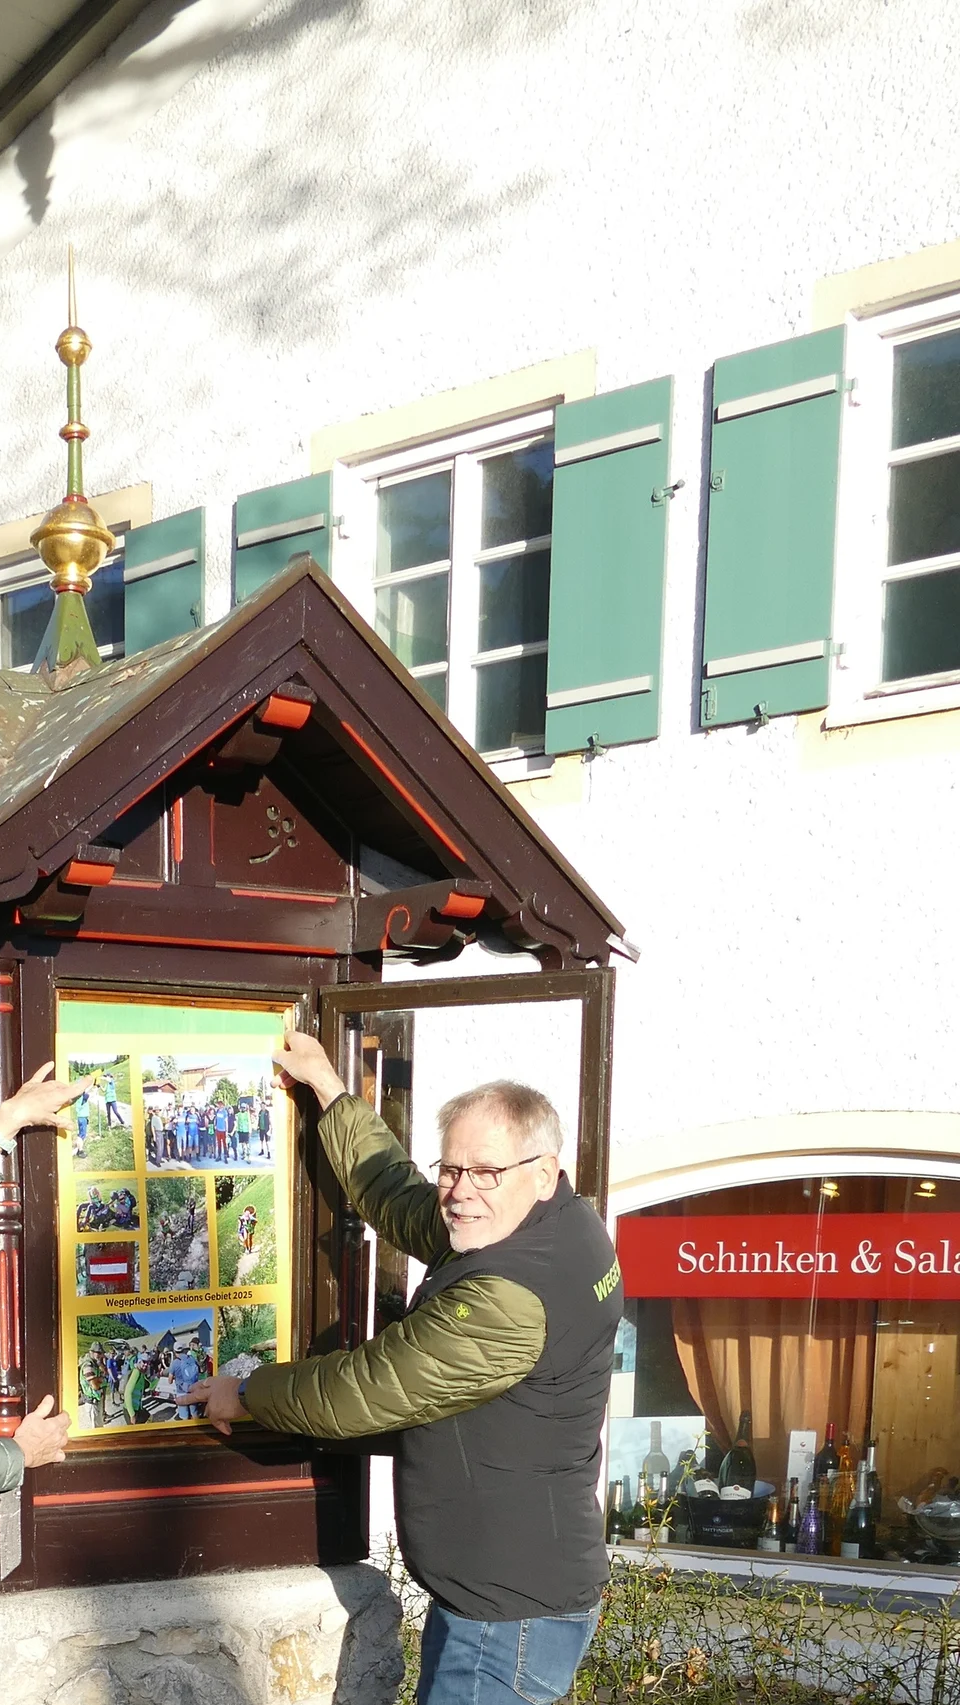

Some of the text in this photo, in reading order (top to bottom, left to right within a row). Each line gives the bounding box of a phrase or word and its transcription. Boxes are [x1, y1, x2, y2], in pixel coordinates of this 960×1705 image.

[676, 1241, 839, 1274] Schinken
[850, 1239, 882, 1274] &
[105, 1290, 253, 1308] Wegepflege im Sektions Gebiet 2025
